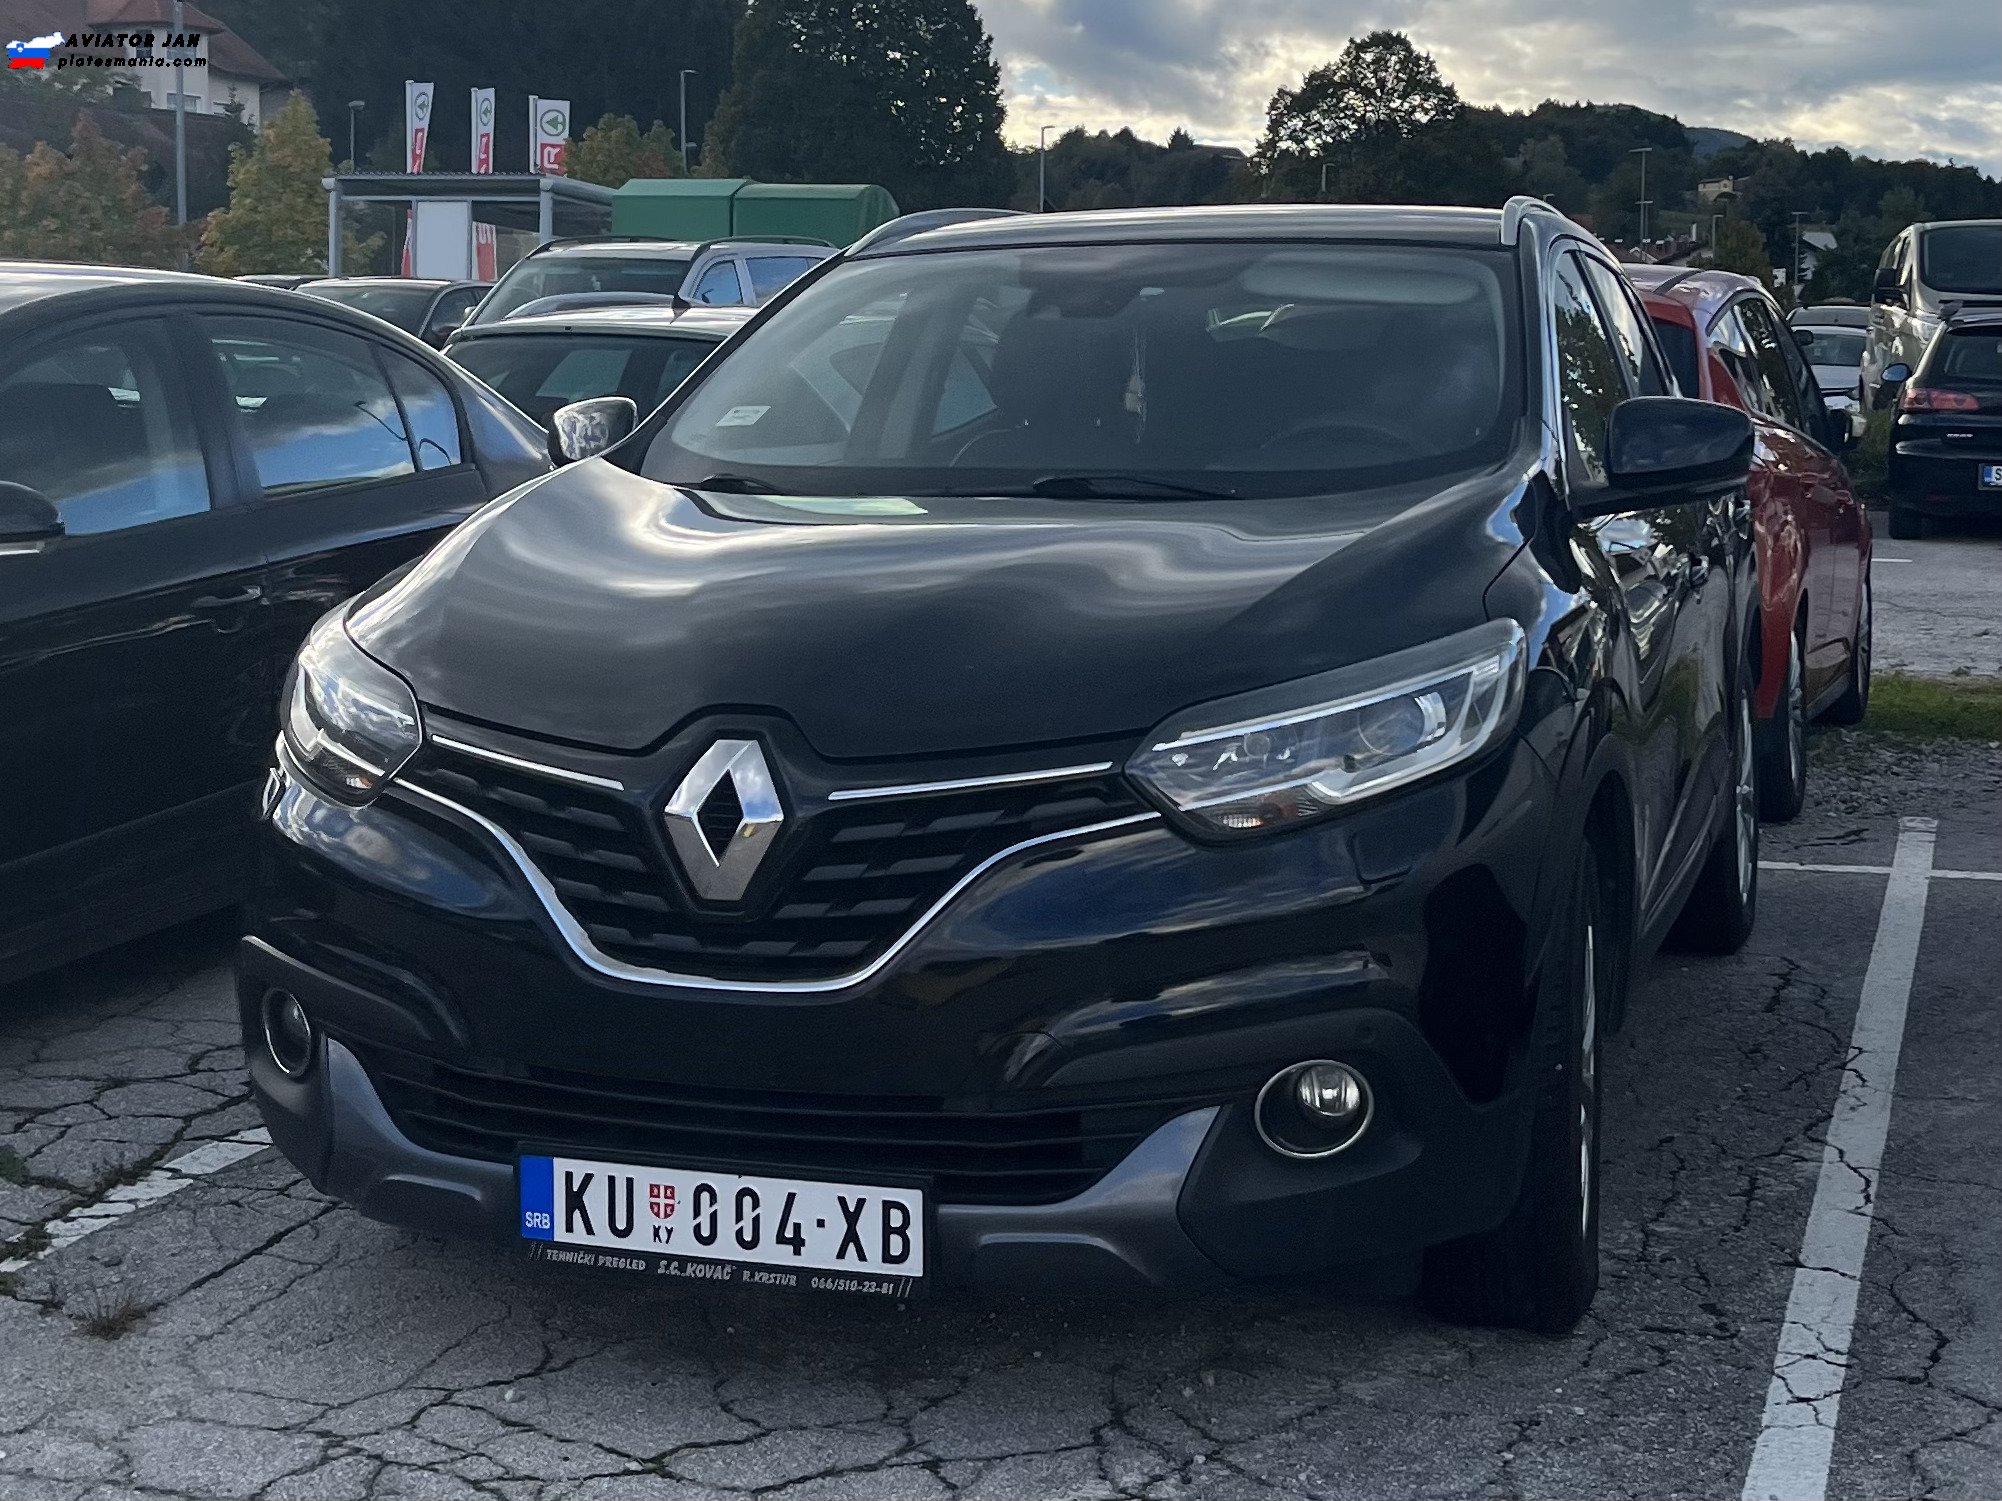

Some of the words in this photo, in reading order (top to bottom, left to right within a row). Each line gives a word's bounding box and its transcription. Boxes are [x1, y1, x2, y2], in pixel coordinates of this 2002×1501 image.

[565, 1170, 635, 1239] KU
[525, 1211, 551, 1229] SRB
[598, 1255, 646, 1271] PREGLED
